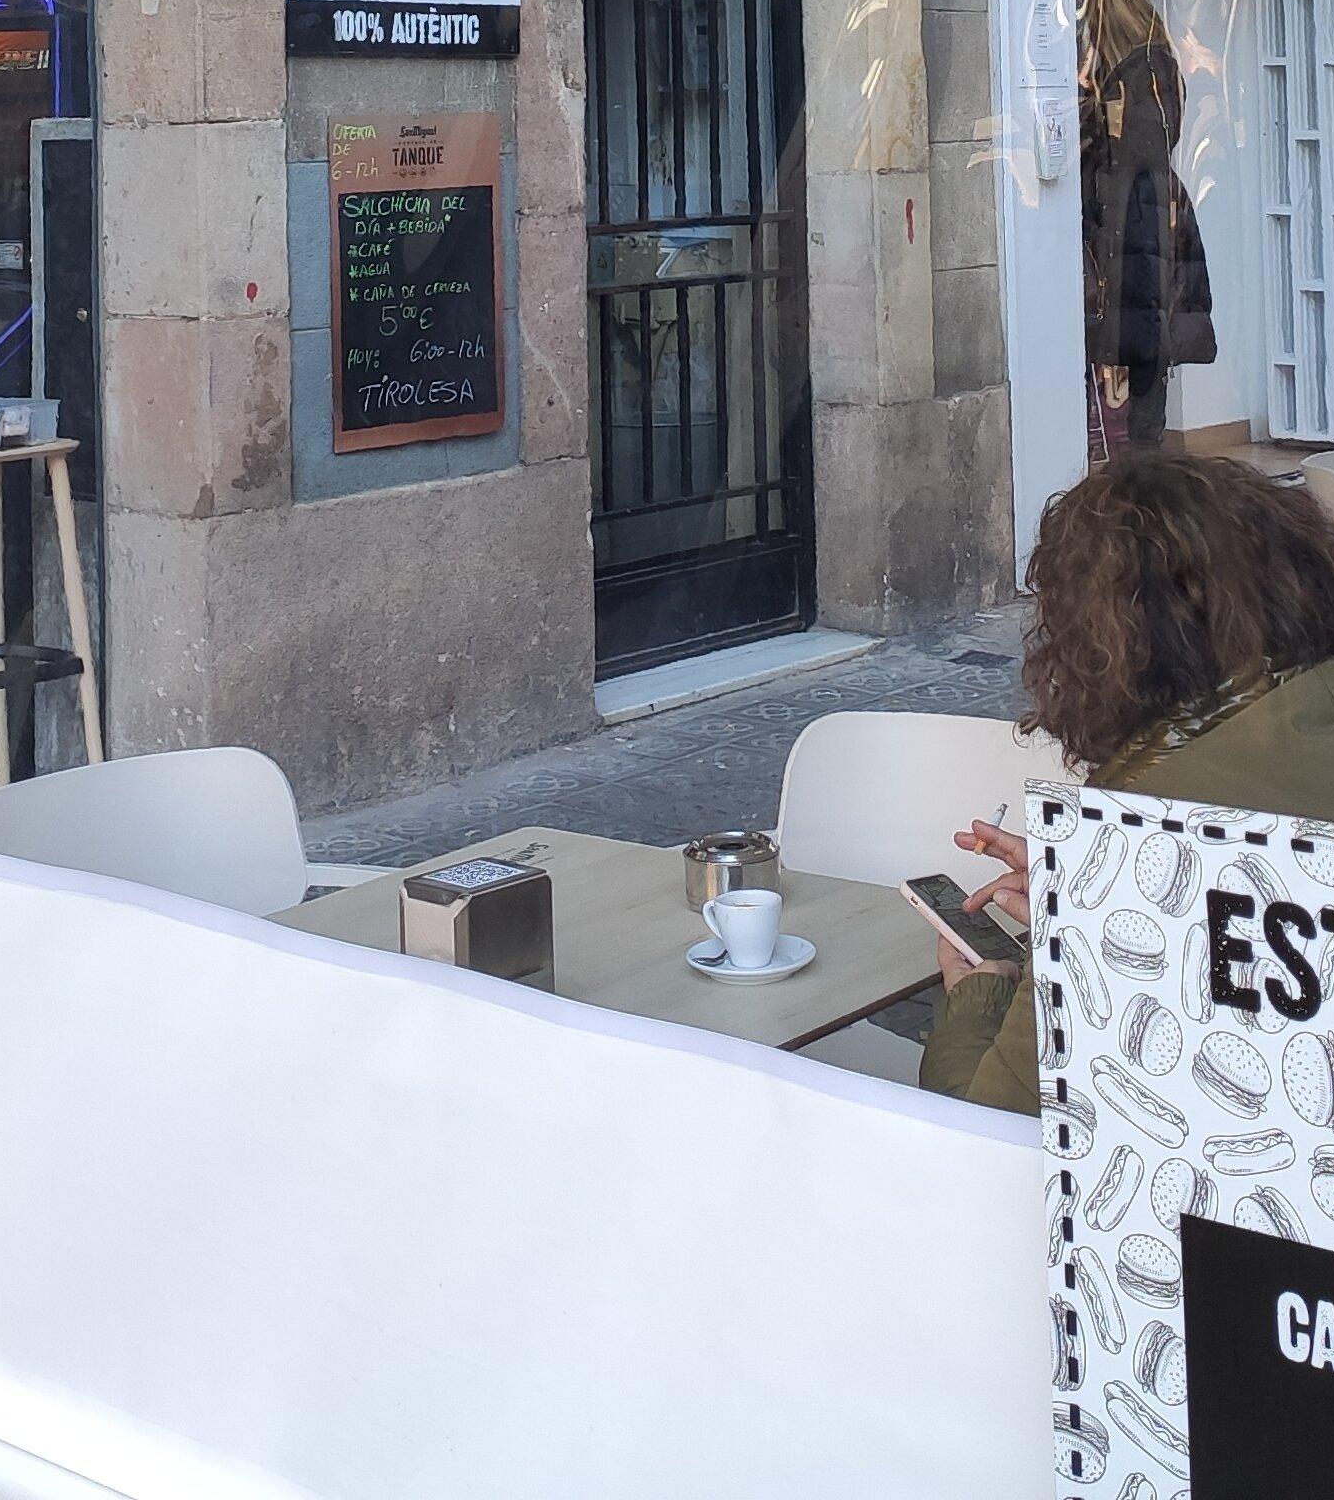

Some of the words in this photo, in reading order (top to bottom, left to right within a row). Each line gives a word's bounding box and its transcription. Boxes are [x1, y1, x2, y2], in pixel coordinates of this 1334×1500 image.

[332, 8, 385, 45] 100%
[390, 6, 480, 46] AUTÈNTIC
[333, 124, 377, 141] OFERTA
[332, 143, 352, 156] DE
[391, 145, 445, 167] TANQUE
[342, 191, 432, 218] SALCHICHA
[441, 196, 468, 212] DEL
[354, 217, 381, 236] DÍA
[401, 285, 417, 299] DE
[424, 281, 472, 296] CERVEZA
[358, 375, 475, 412] TIROLESA
